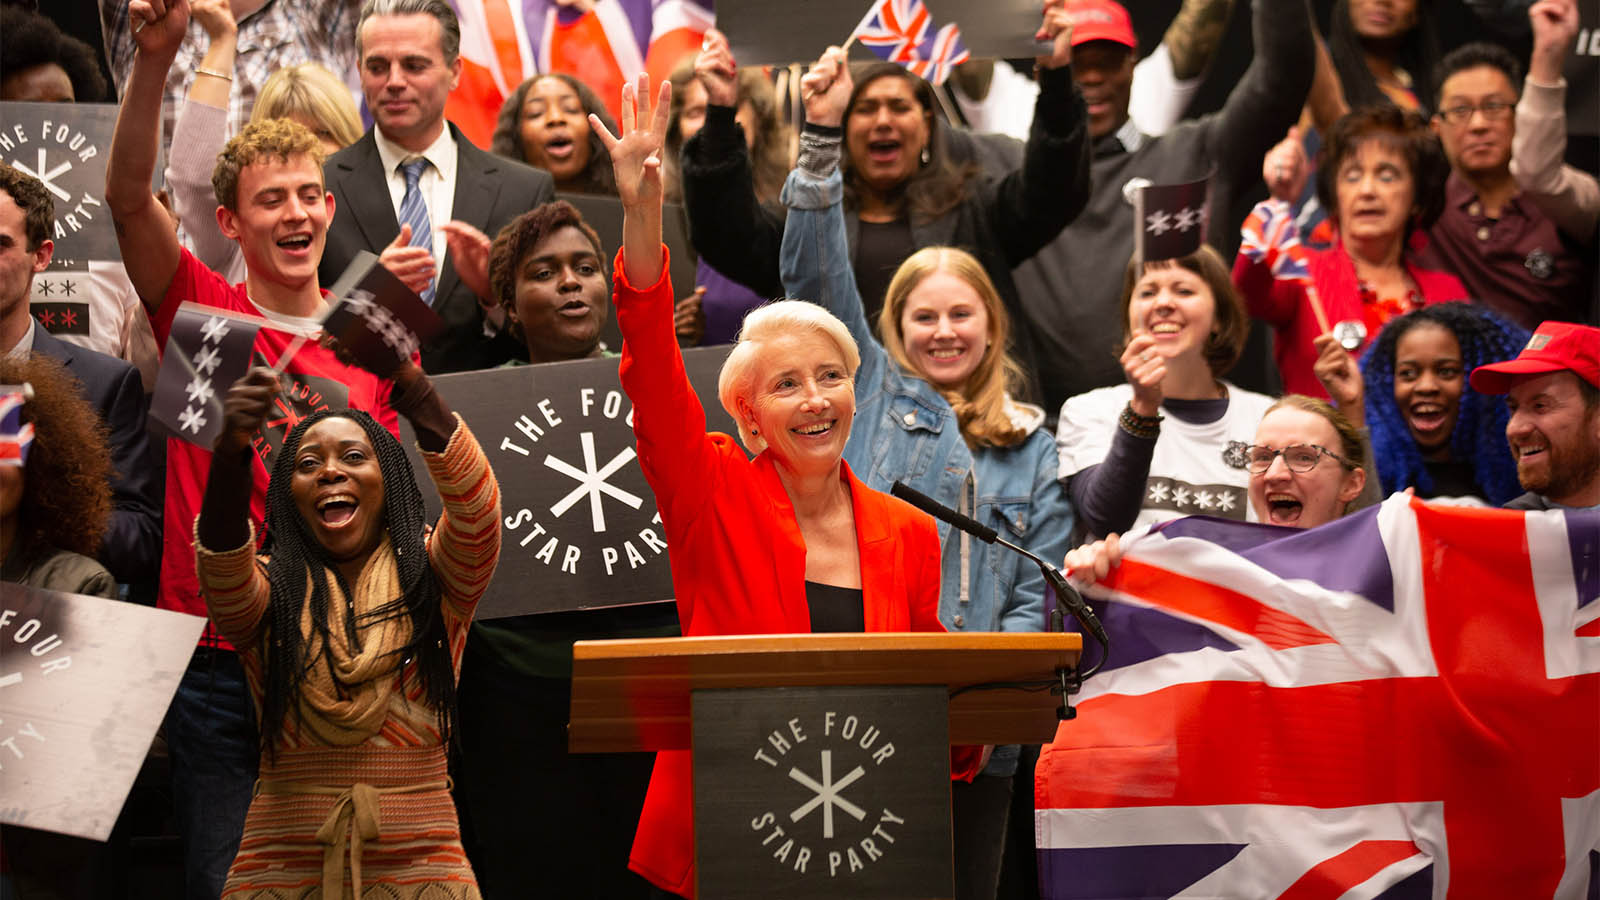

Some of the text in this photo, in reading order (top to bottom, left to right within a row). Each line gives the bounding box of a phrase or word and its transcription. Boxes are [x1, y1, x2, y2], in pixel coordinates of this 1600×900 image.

[0, 120, 97, 162] HE FOUR
[54, 192, 101, 239] ARTY
[500, 388, 634, 456] THE FO
[504, 508, 668, 576] STAR PAR
[0, 609, 72, 675] FOUR
[754, 712, 895, 767] THE FOUR
[751, 808, 904, 877] STAR PARTY
